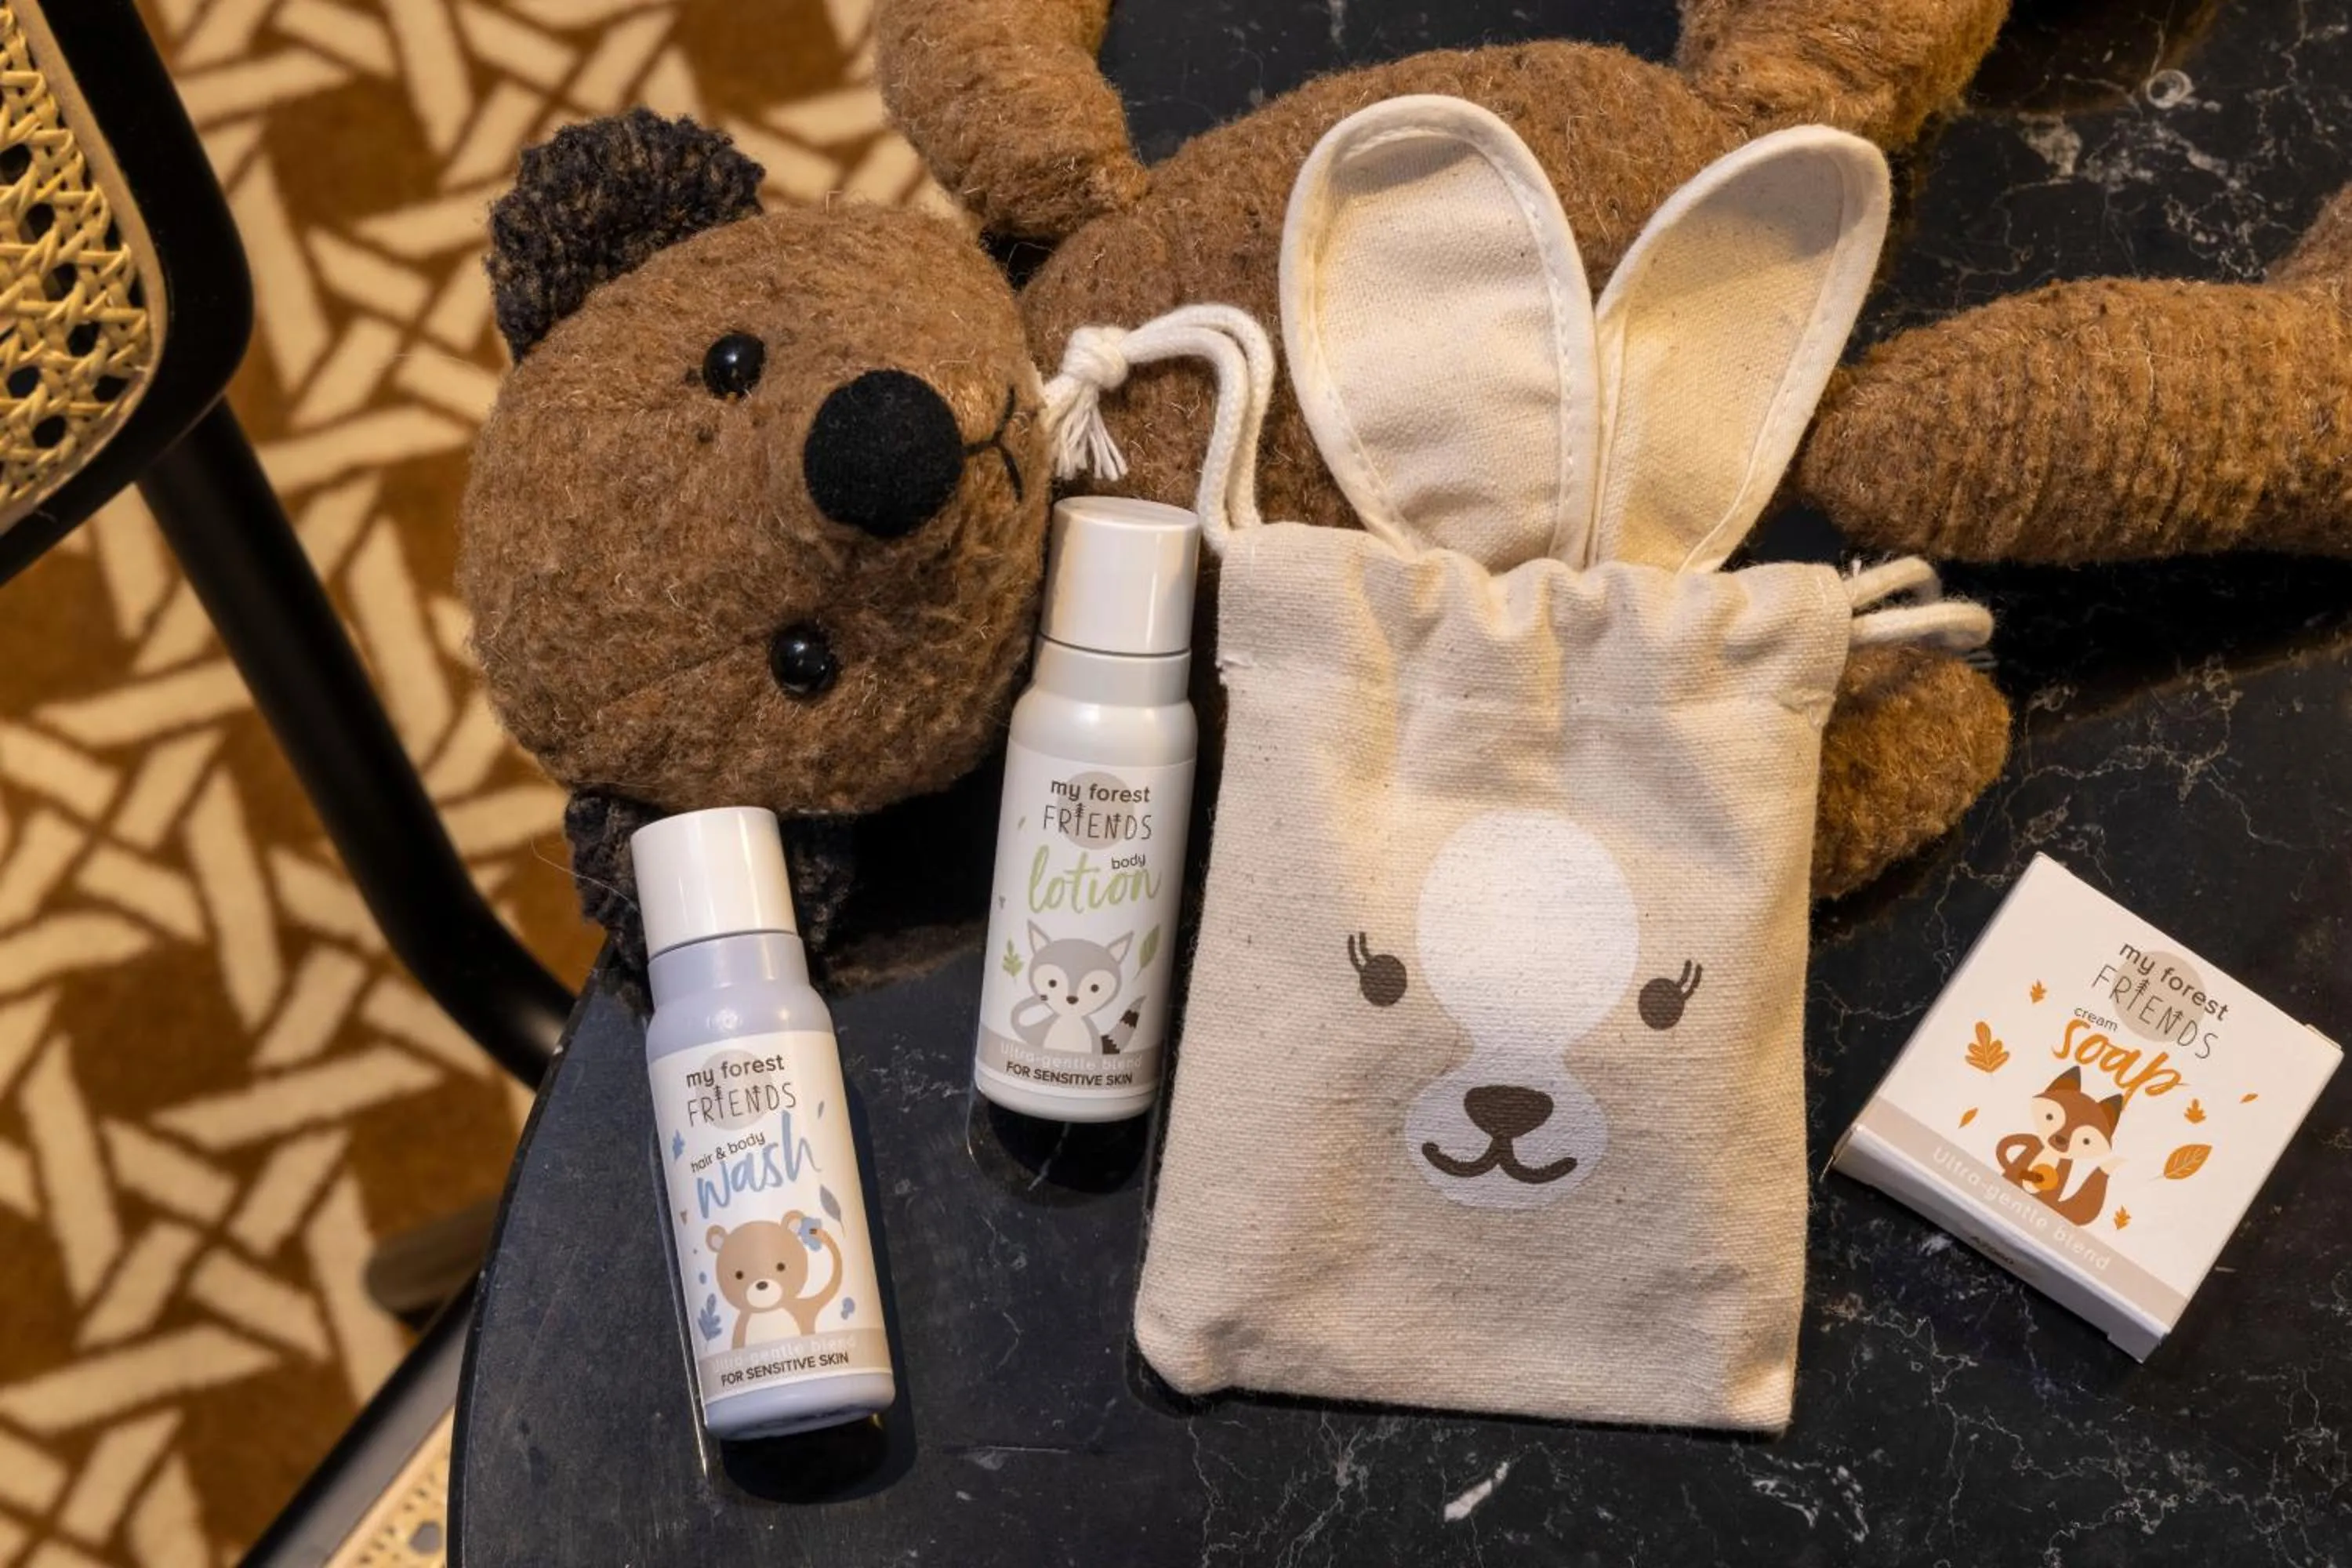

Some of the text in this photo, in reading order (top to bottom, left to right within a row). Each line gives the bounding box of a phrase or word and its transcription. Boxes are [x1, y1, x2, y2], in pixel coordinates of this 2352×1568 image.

[1051, 779, 1151, 803] my forest
[1043, 803, 1152, 840] FRIENDS
[1029, 844, 1162, 914] lotion
[1111, 853, 1145, 869] body
[2119, 943, 2229, 1022] my forest
[2074, 1007, 2118, 1033] cream
[2091, 964, 2219, 1059] FRIENDS
[687, 1054, 785, 1088] my forest
[1006, 1061, 1133, 1086] FOR SENSITIVE SKIN
[2051, 1018, 2187, 1112] soap
[687, 1082, 797, 1127] FRIENDS
[691, 1131, 766, 1173] hair & body
[696, 1109, 822, 1219] wash
[2053, 1225, 2111, 1270] blend
[720, 1351, 849, 1386] FOR SENSITIVE SKIN
